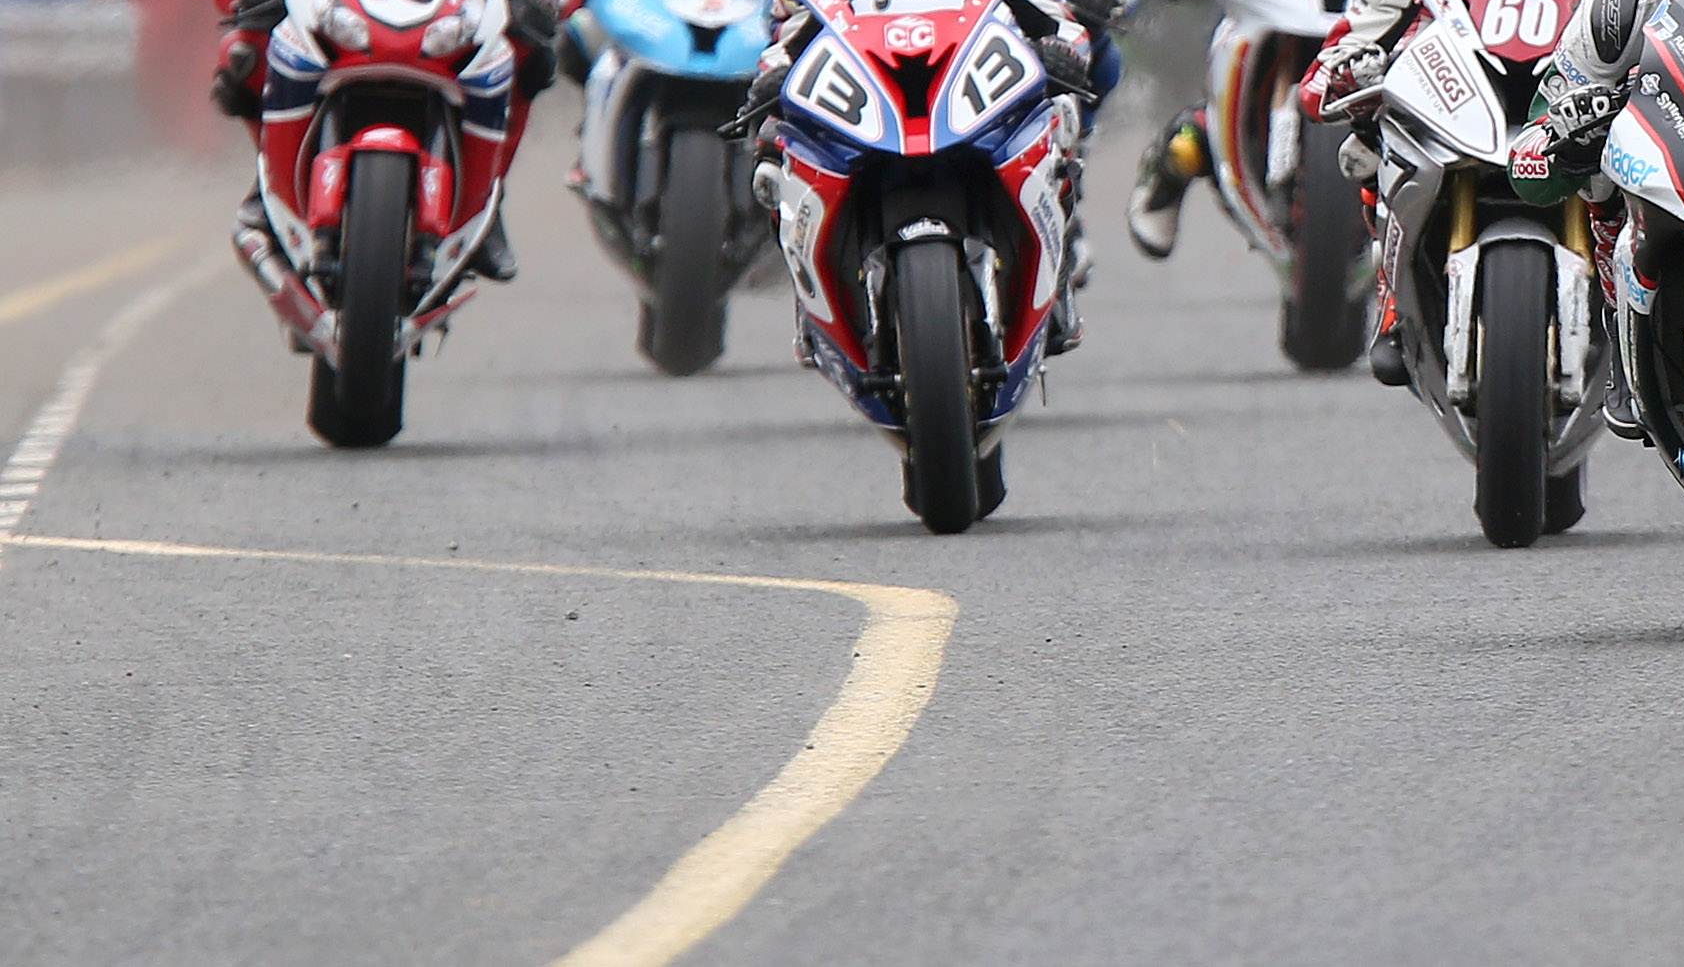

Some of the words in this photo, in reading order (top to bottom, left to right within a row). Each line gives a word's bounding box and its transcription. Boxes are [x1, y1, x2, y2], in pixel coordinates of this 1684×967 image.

[797, 47, 869, 126] 13
[959, 36, 1026, 117] 13
[1419, 42, 1466, 103] BRIGGS
[1513, 160, 1549, 177] TOOLS
